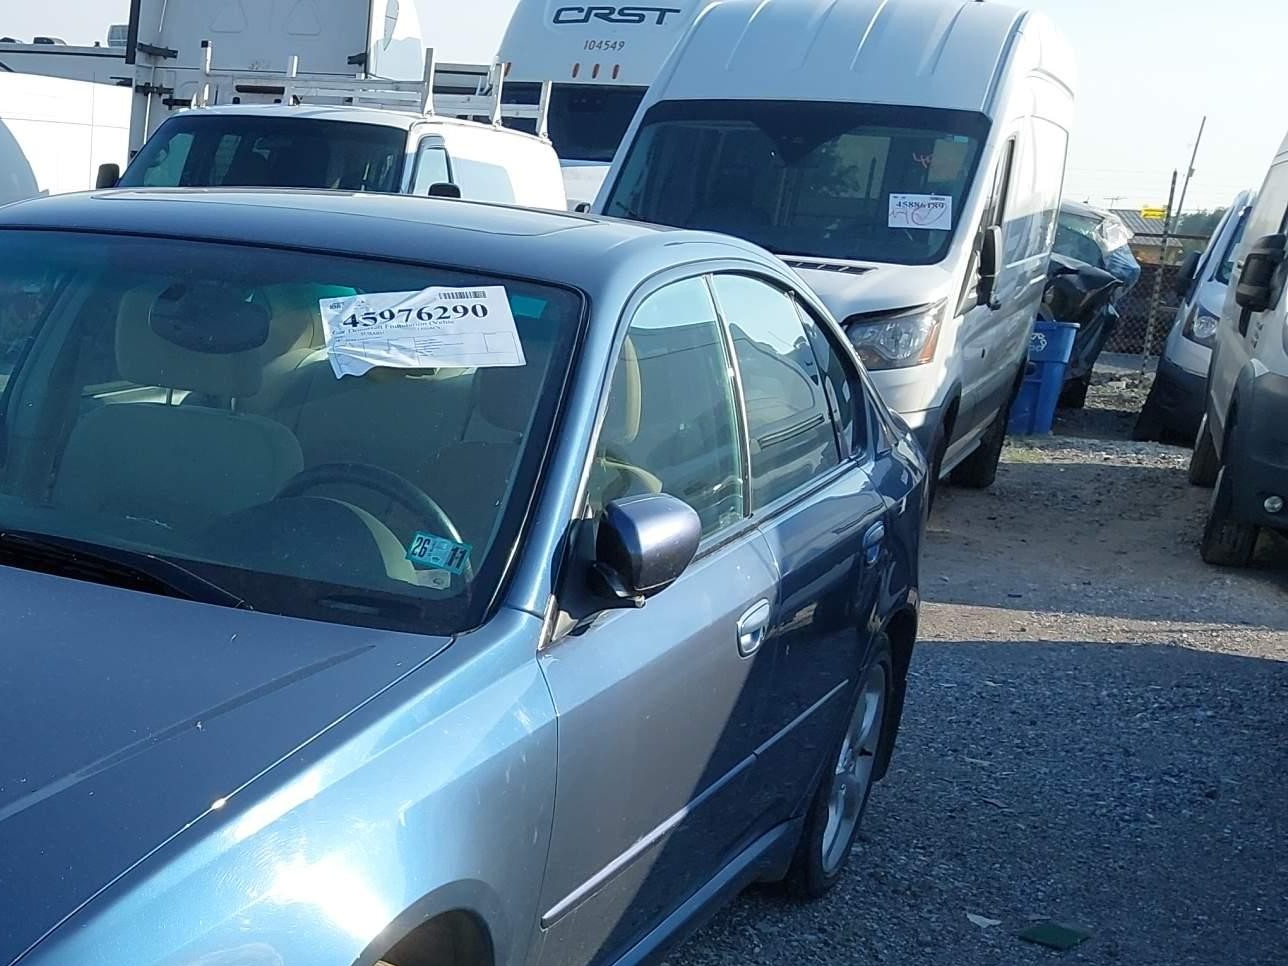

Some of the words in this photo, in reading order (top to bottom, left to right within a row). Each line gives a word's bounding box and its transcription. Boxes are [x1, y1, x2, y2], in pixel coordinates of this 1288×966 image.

[553, 6, 681, 26] CRST
[583, 40, 625, 51] 104549
[342, 303, 488, 327] 45976290
[412, 536, 431, 558] 26
[447, 546, 468, 569] 11
